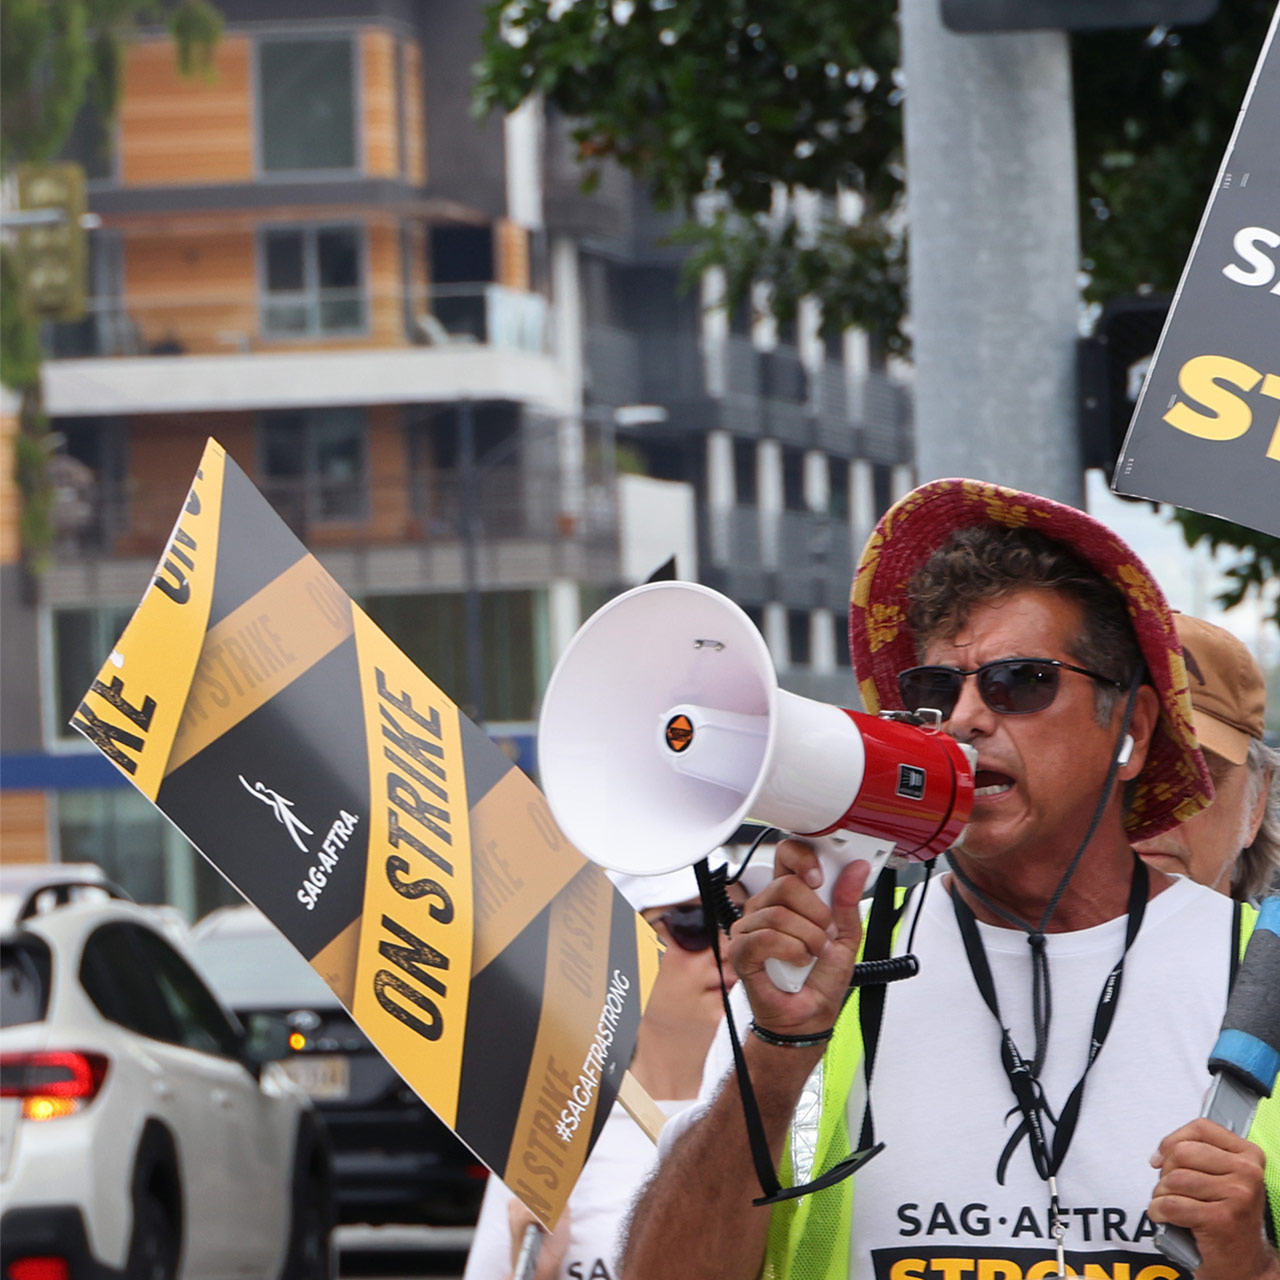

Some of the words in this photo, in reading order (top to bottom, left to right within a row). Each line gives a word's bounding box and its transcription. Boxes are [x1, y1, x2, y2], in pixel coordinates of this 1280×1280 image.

[374, 665, 455, 926] STRIKE
[373, 913, 451, 1042] ON
[554, 968, 631, 1143] #SAGAFTRASTRONG
